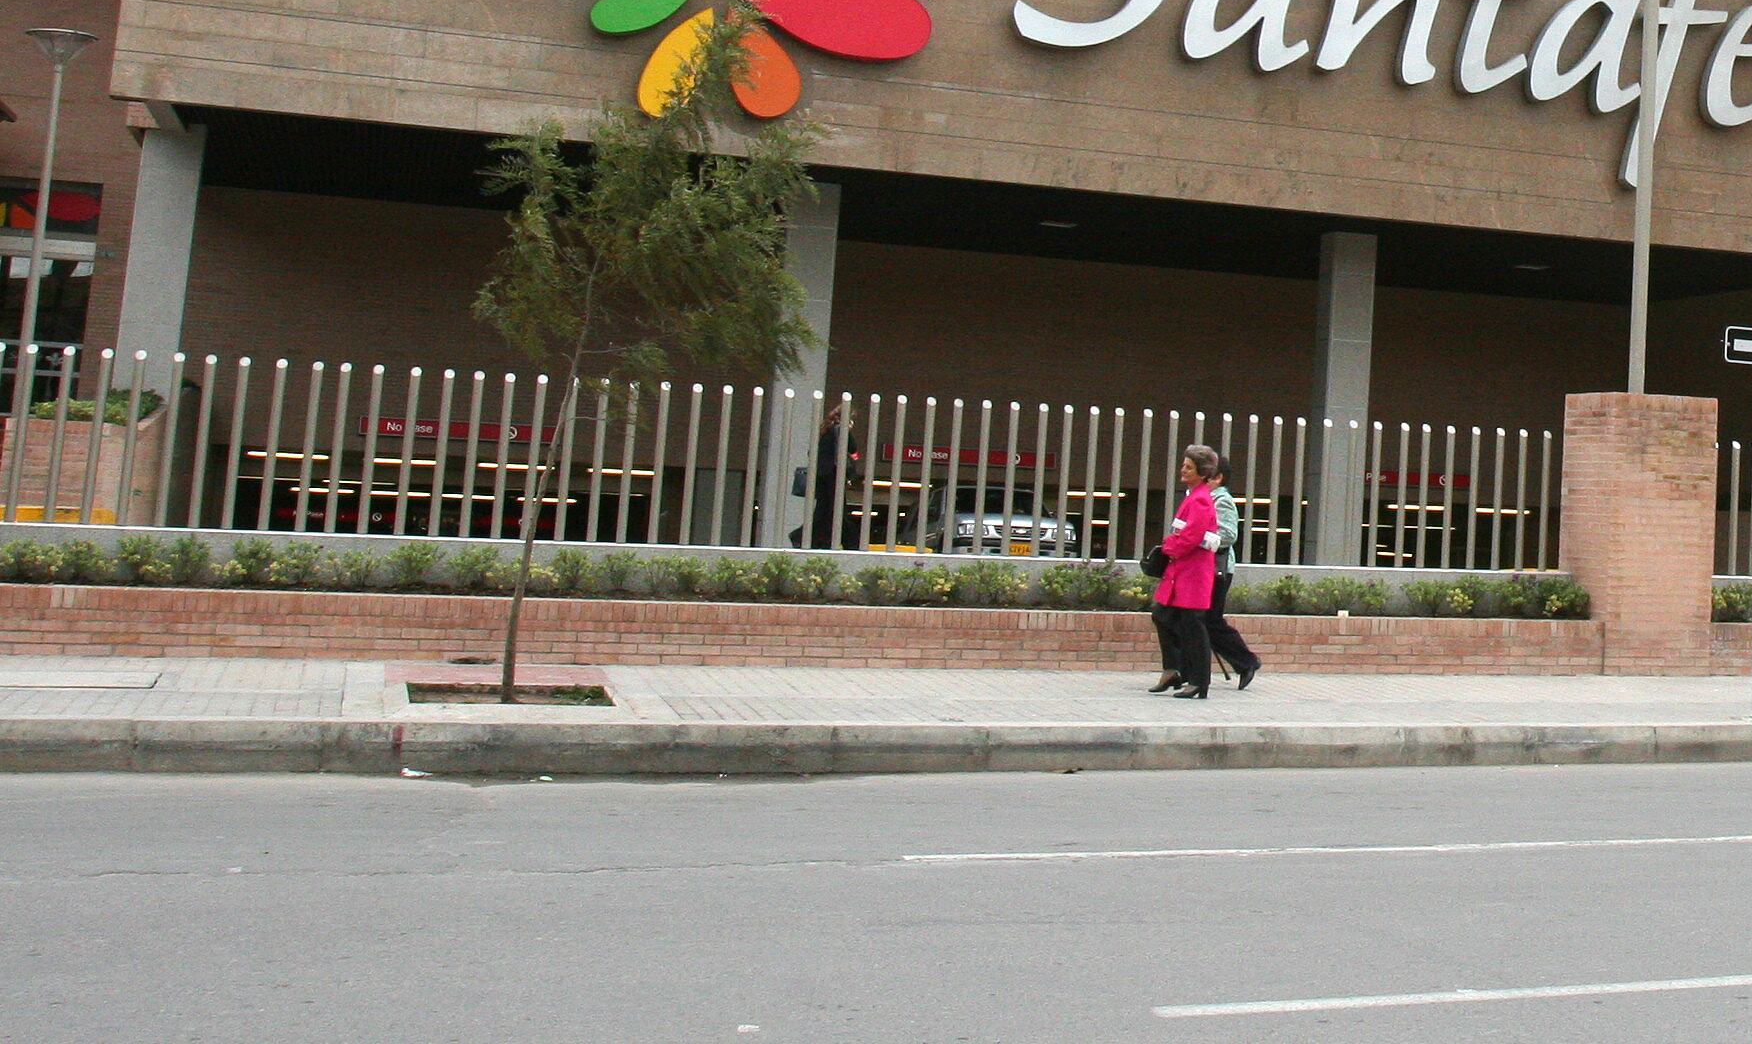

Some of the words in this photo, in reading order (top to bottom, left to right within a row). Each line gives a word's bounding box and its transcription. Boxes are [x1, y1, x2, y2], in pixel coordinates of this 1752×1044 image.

[386, 421, 403, 432] No
[407, 423, 433, 434] ase
[908, 449, 922, 459] No
